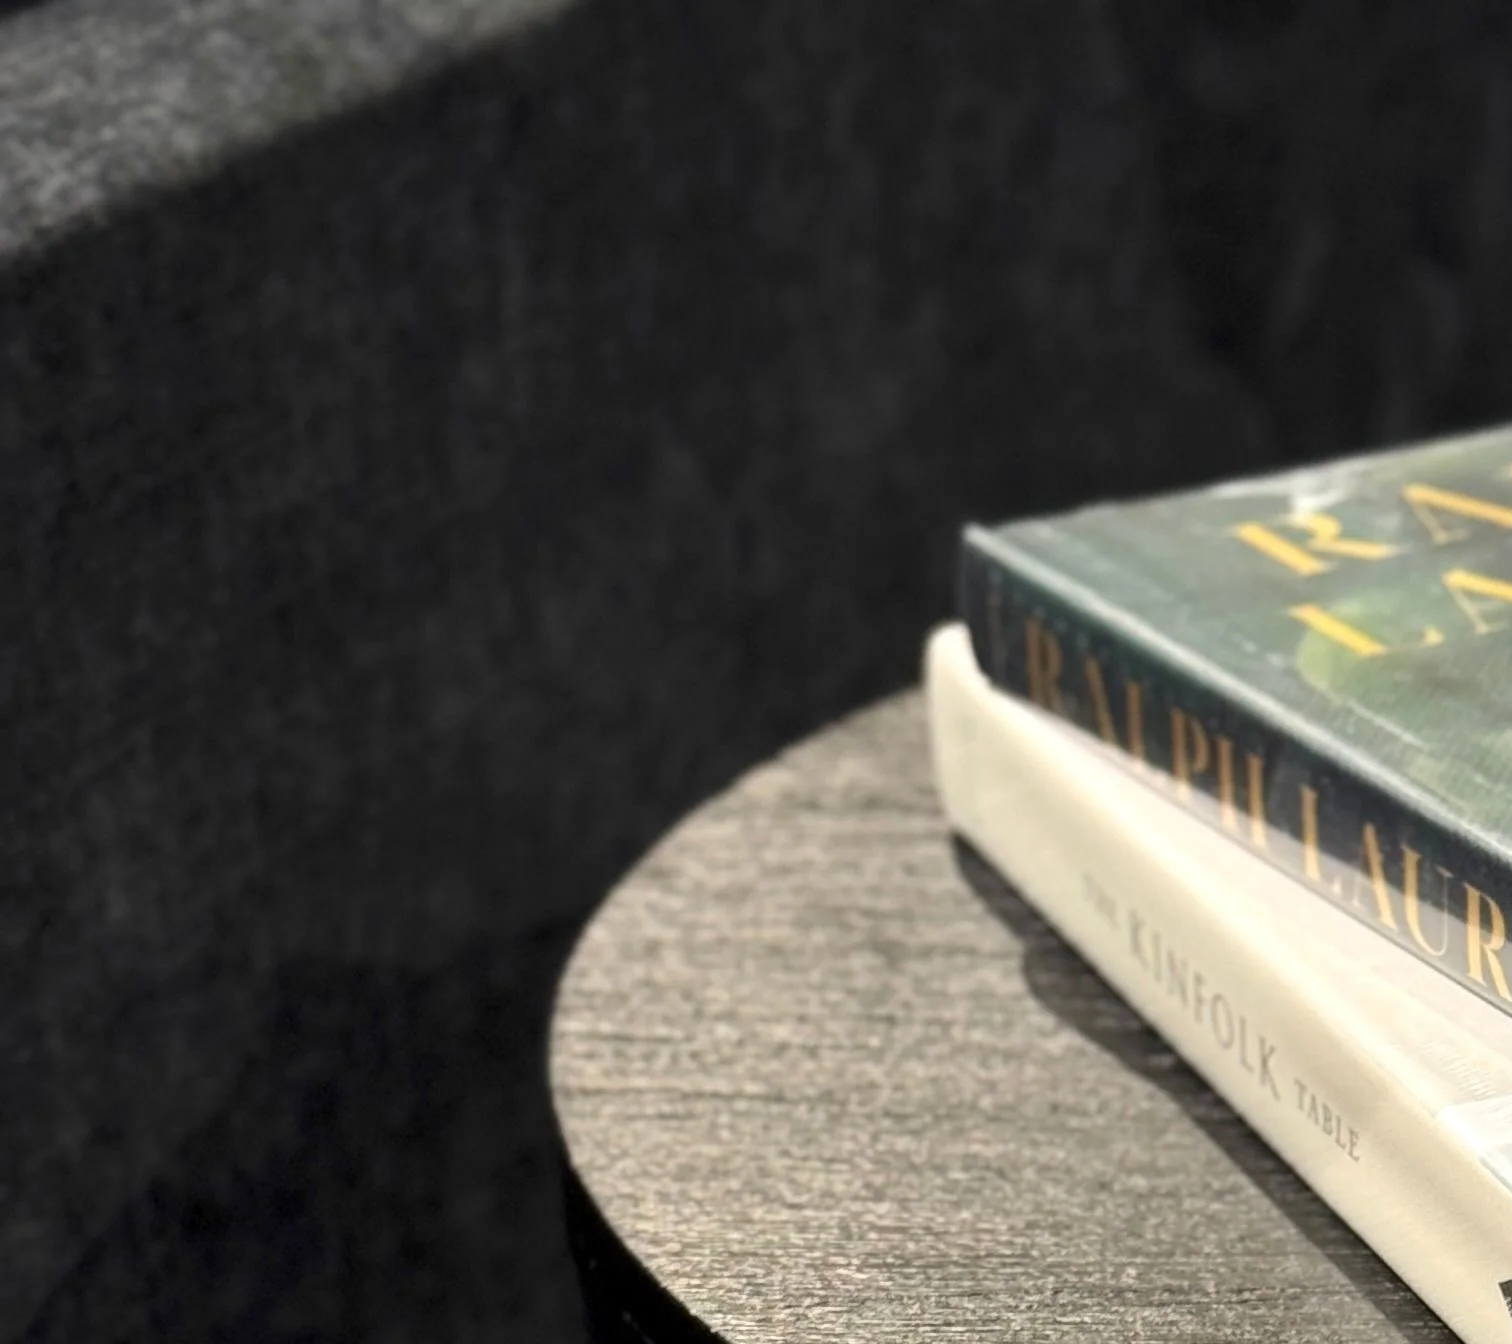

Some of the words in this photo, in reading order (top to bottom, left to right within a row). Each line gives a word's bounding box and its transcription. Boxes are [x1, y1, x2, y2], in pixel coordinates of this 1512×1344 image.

[1024, 614, 1268, 850] RALPH
[1126, 906, 1282, 1101] KINFOLK
[1293, 1077, 1361, 1163] TABLE
